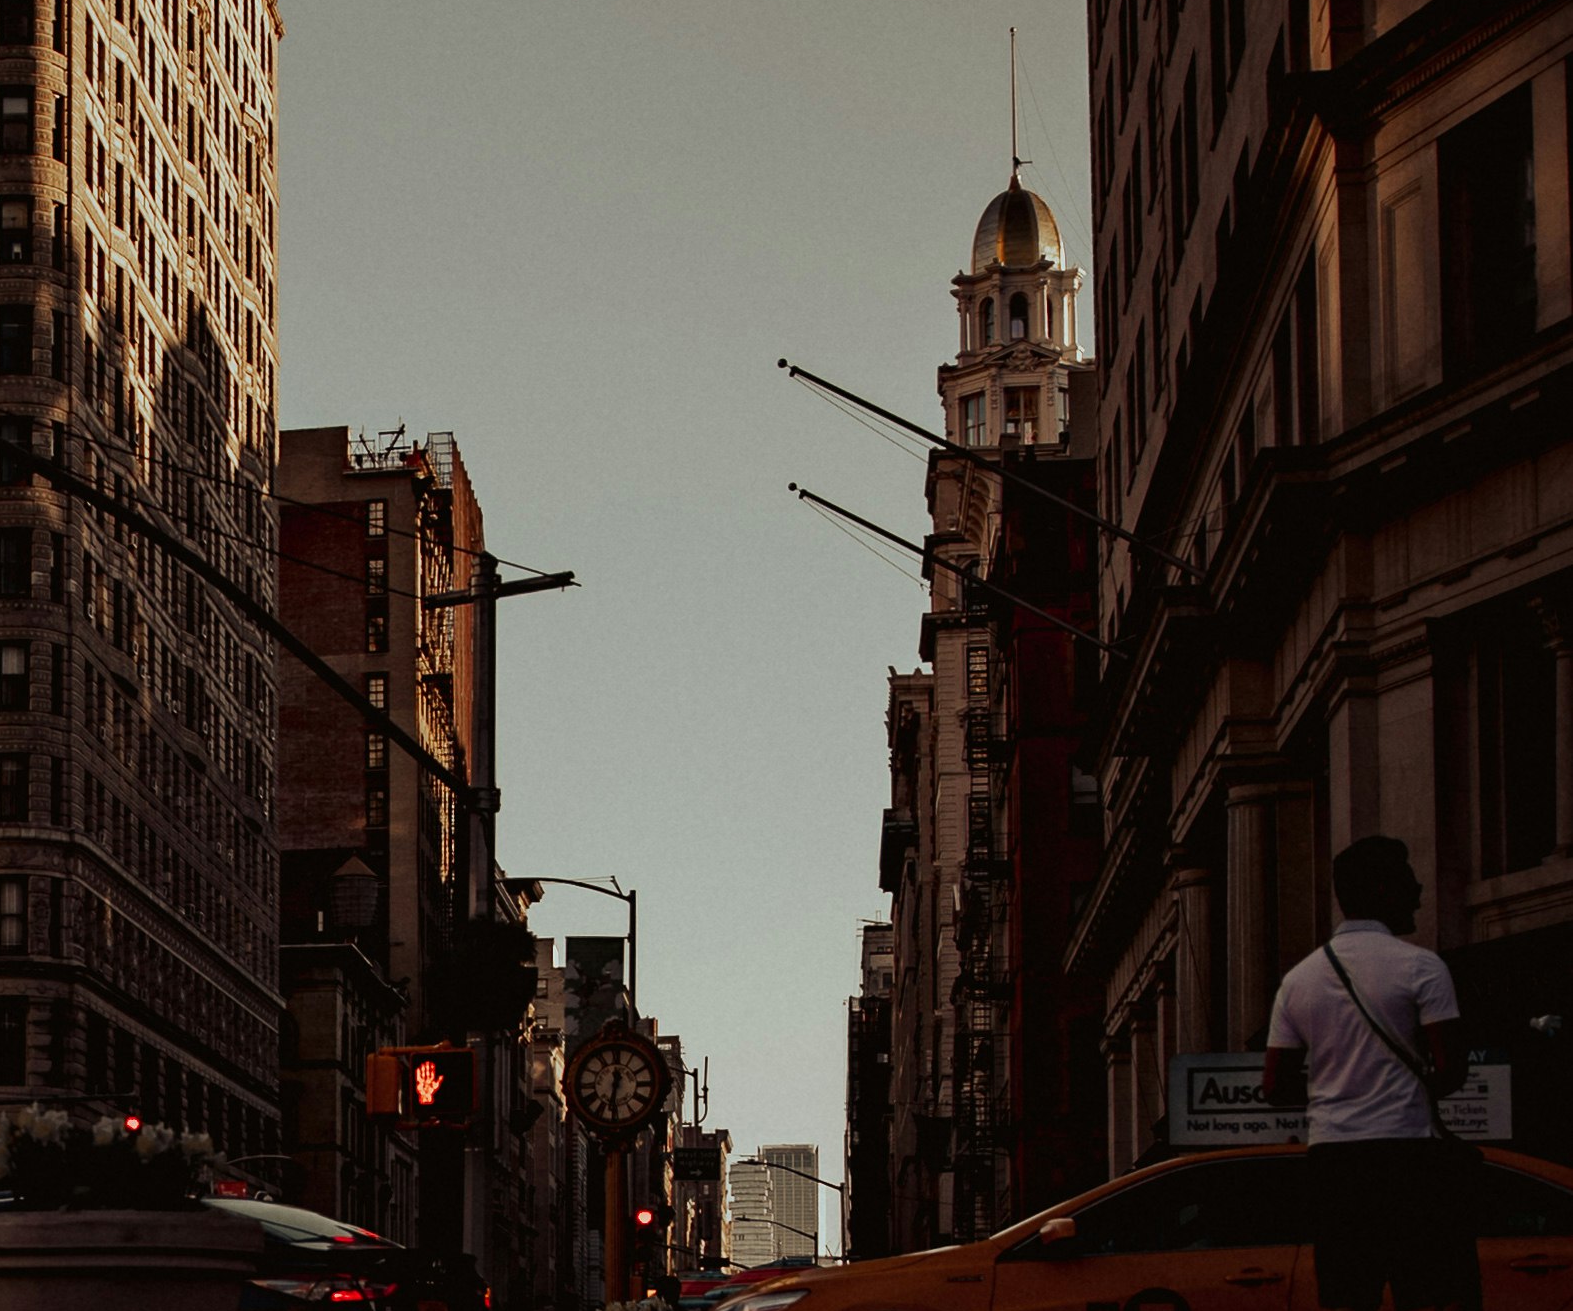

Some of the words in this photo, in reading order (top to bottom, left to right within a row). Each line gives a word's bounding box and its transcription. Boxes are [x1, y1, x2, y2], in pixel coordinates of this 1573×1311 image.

[1199, 1077, 1266, 1104] Ausc
[1187, 1119, 1210, 1132] Not
[1213, 1118, 1240, 1134] long
[1243, 1121, 1271, 1133] ago.
[1277, 1117, 1300, 1130] Not
[1443, 1116, 1488, 1129] witz.nyc
